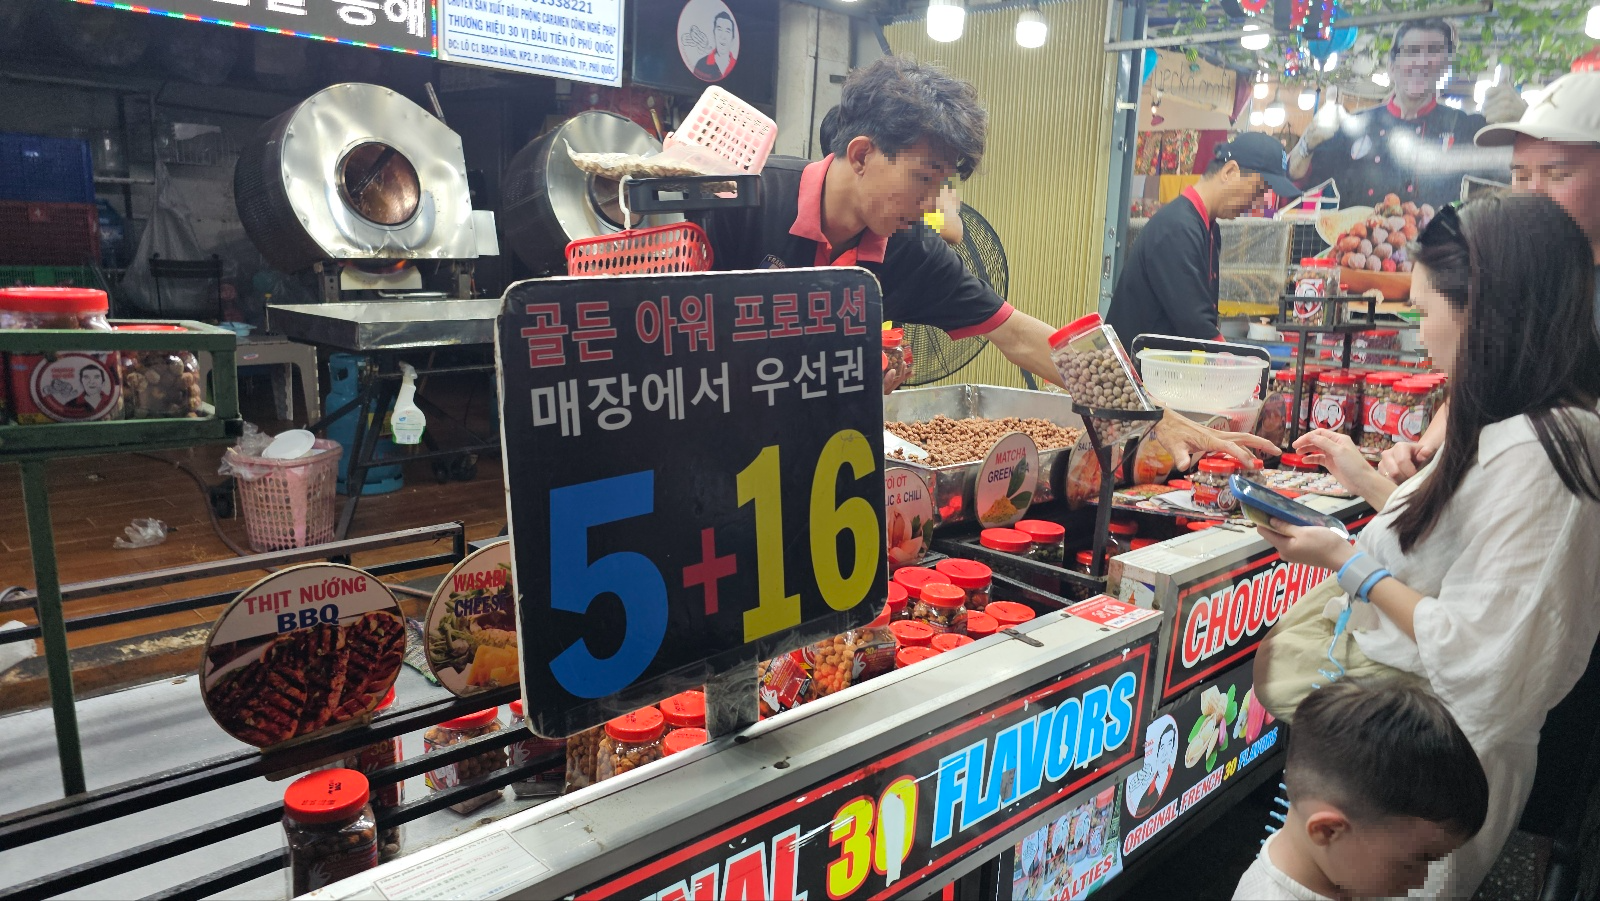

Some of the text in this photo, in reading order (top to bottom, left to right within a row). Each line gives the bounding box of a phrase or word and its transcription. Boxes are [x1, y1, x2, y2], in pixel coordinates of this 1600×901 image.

[508, 26, 519, 37] 30
[520, 285, 867, 368] 골든 아워 프로모션
[530, 346, 865, 437] 매장에서 우선권
[995, 446, 1026, 465] MATCHA
[987, 466, 1014, 483] GREEN
[896, 493, 902, 505] &
[903, 488, 922, 503] CHILI
[244, 575, 367, 615] THỊT NƯỚNG
[453, 569, 507, 593] WASABI
[277, 603, 340, 634] BBQ
[825, 774, 918, 899] 30
[930, 671, 1137, 848] FLAVORS
[1123, 726, 1278, 856] ORIGINAL FRENCH 30 FLAVORS
